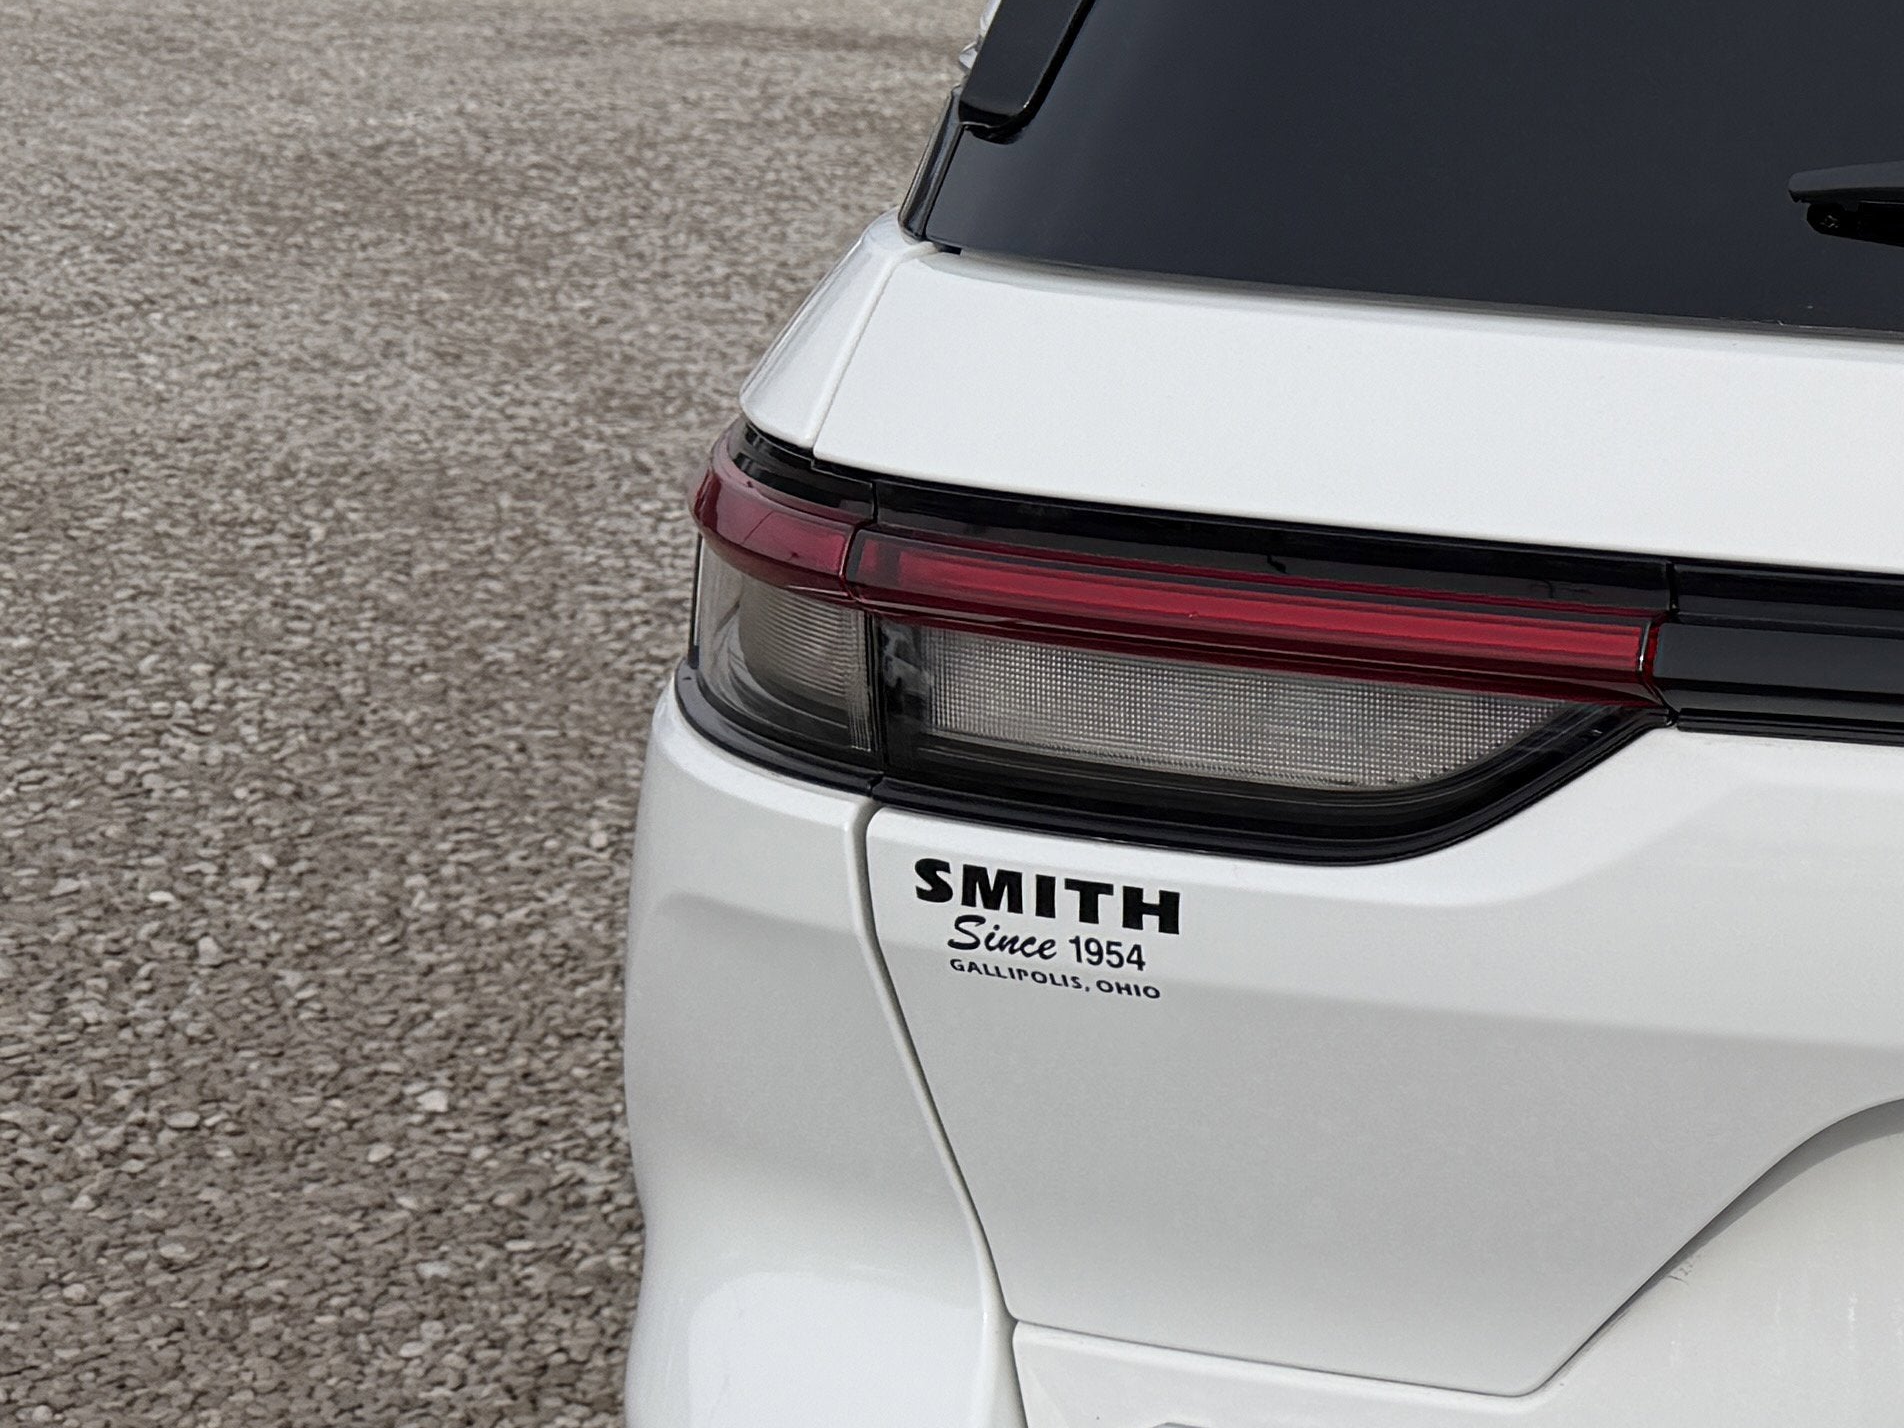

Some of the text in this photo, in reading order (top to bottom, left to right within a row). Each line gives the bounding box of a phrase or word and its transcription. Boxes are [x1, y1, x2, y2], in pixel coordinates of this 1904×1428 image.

[914, 857, 1181, 935] SMITH
[947, 914, 1146, 971] Since 1954
[949, 958, 1161, 1000] GALLIPOLIS, OHIO
